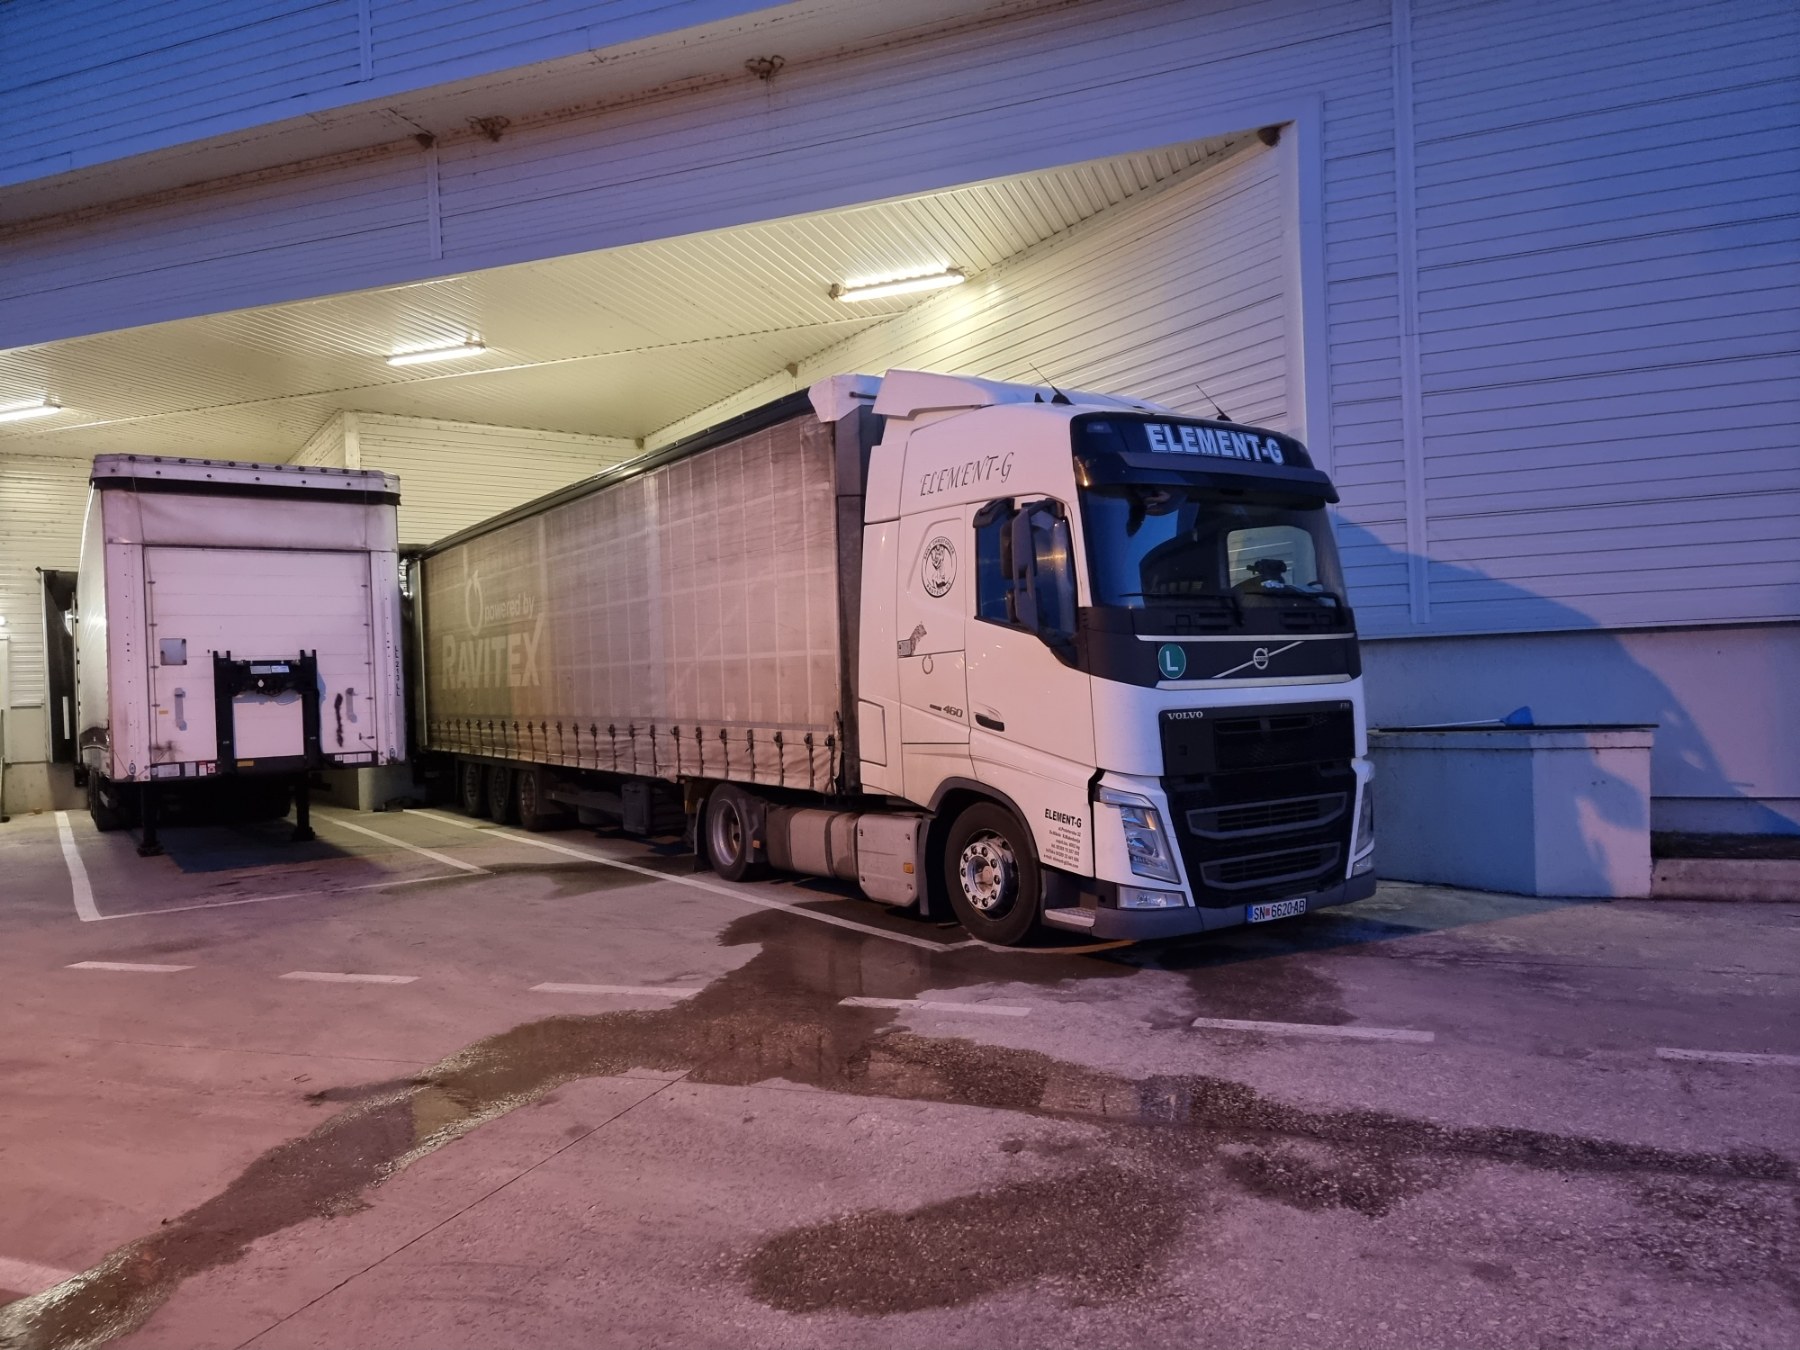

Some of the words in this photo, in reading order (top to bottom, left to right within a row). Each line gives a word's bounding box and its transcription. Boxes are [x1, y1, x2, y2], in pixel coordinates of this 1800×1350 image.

[1144, 422, 1285, 465] ELEMENT-G
[920, 451, 1014, 497] ELEMENT-G
[484, 593, 520, 625] powered
[523, 592, 535, 619] by
[442, 612, 545, 690] RAVITEX
[1165, 650, 1179, 671] L
[943, 705, 963, 718] 460
[1168, 711, 1204, 720] VOLVO
[1044, 808, 1082, 828] ELEMENT-G
[1253, 906, 1265, 920] SN
